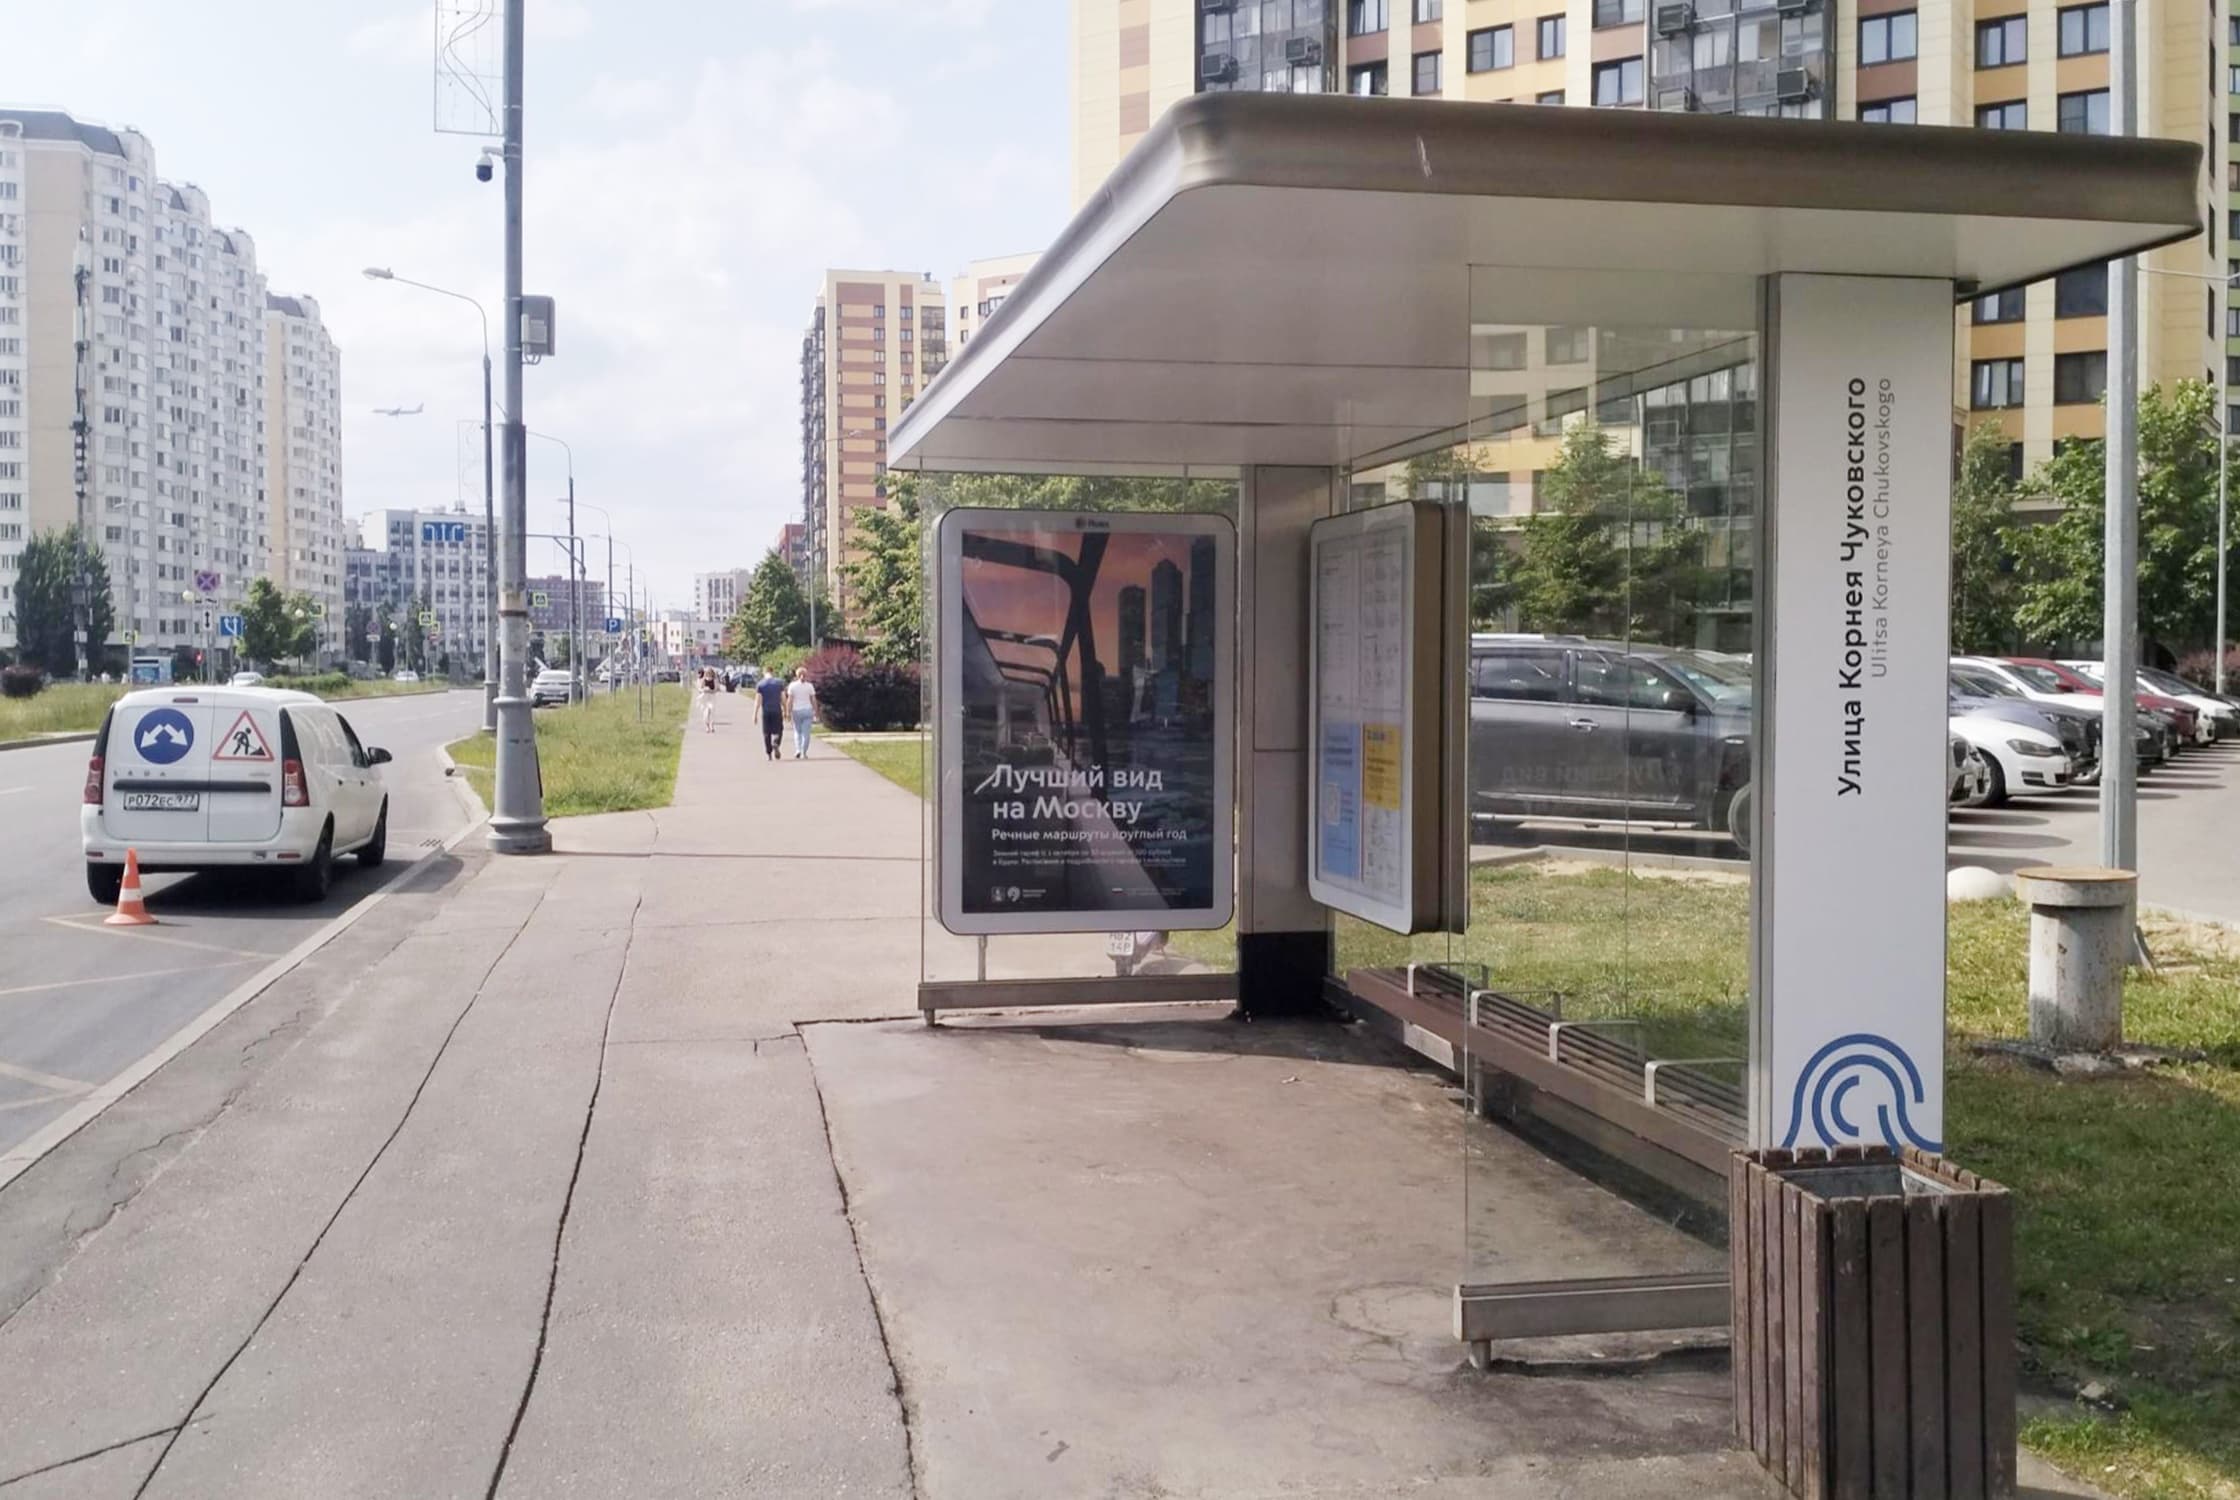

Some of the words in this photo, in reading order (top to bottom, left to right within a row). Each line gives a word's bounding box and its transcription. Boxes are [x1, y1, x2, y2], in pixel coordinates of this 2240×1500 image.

[1840, 377, 1870, 562] Чуковского
[1873, 377, 1895, 519] Chukovskogo
[1872, 525, 1892, 610] Korneya
[1838, 571, 1868, 689] Корнея
[1871, 616, 1888, 678] Ulitsa
[991, 764, 1104, 794] Лучший
[1113, 770, 1163, 791] вид
[1838, 699, 1866, 796] Улица
[991, 828, 1040, 841] Речные
[1043, 829, 1110, 843] маршруты
[1112, 828, 1164, 843] круглый
[1167, 830, 1187, 841] год
[993, 801, 1025, 819] на
[1032, 796, 1143, 824] Москву
